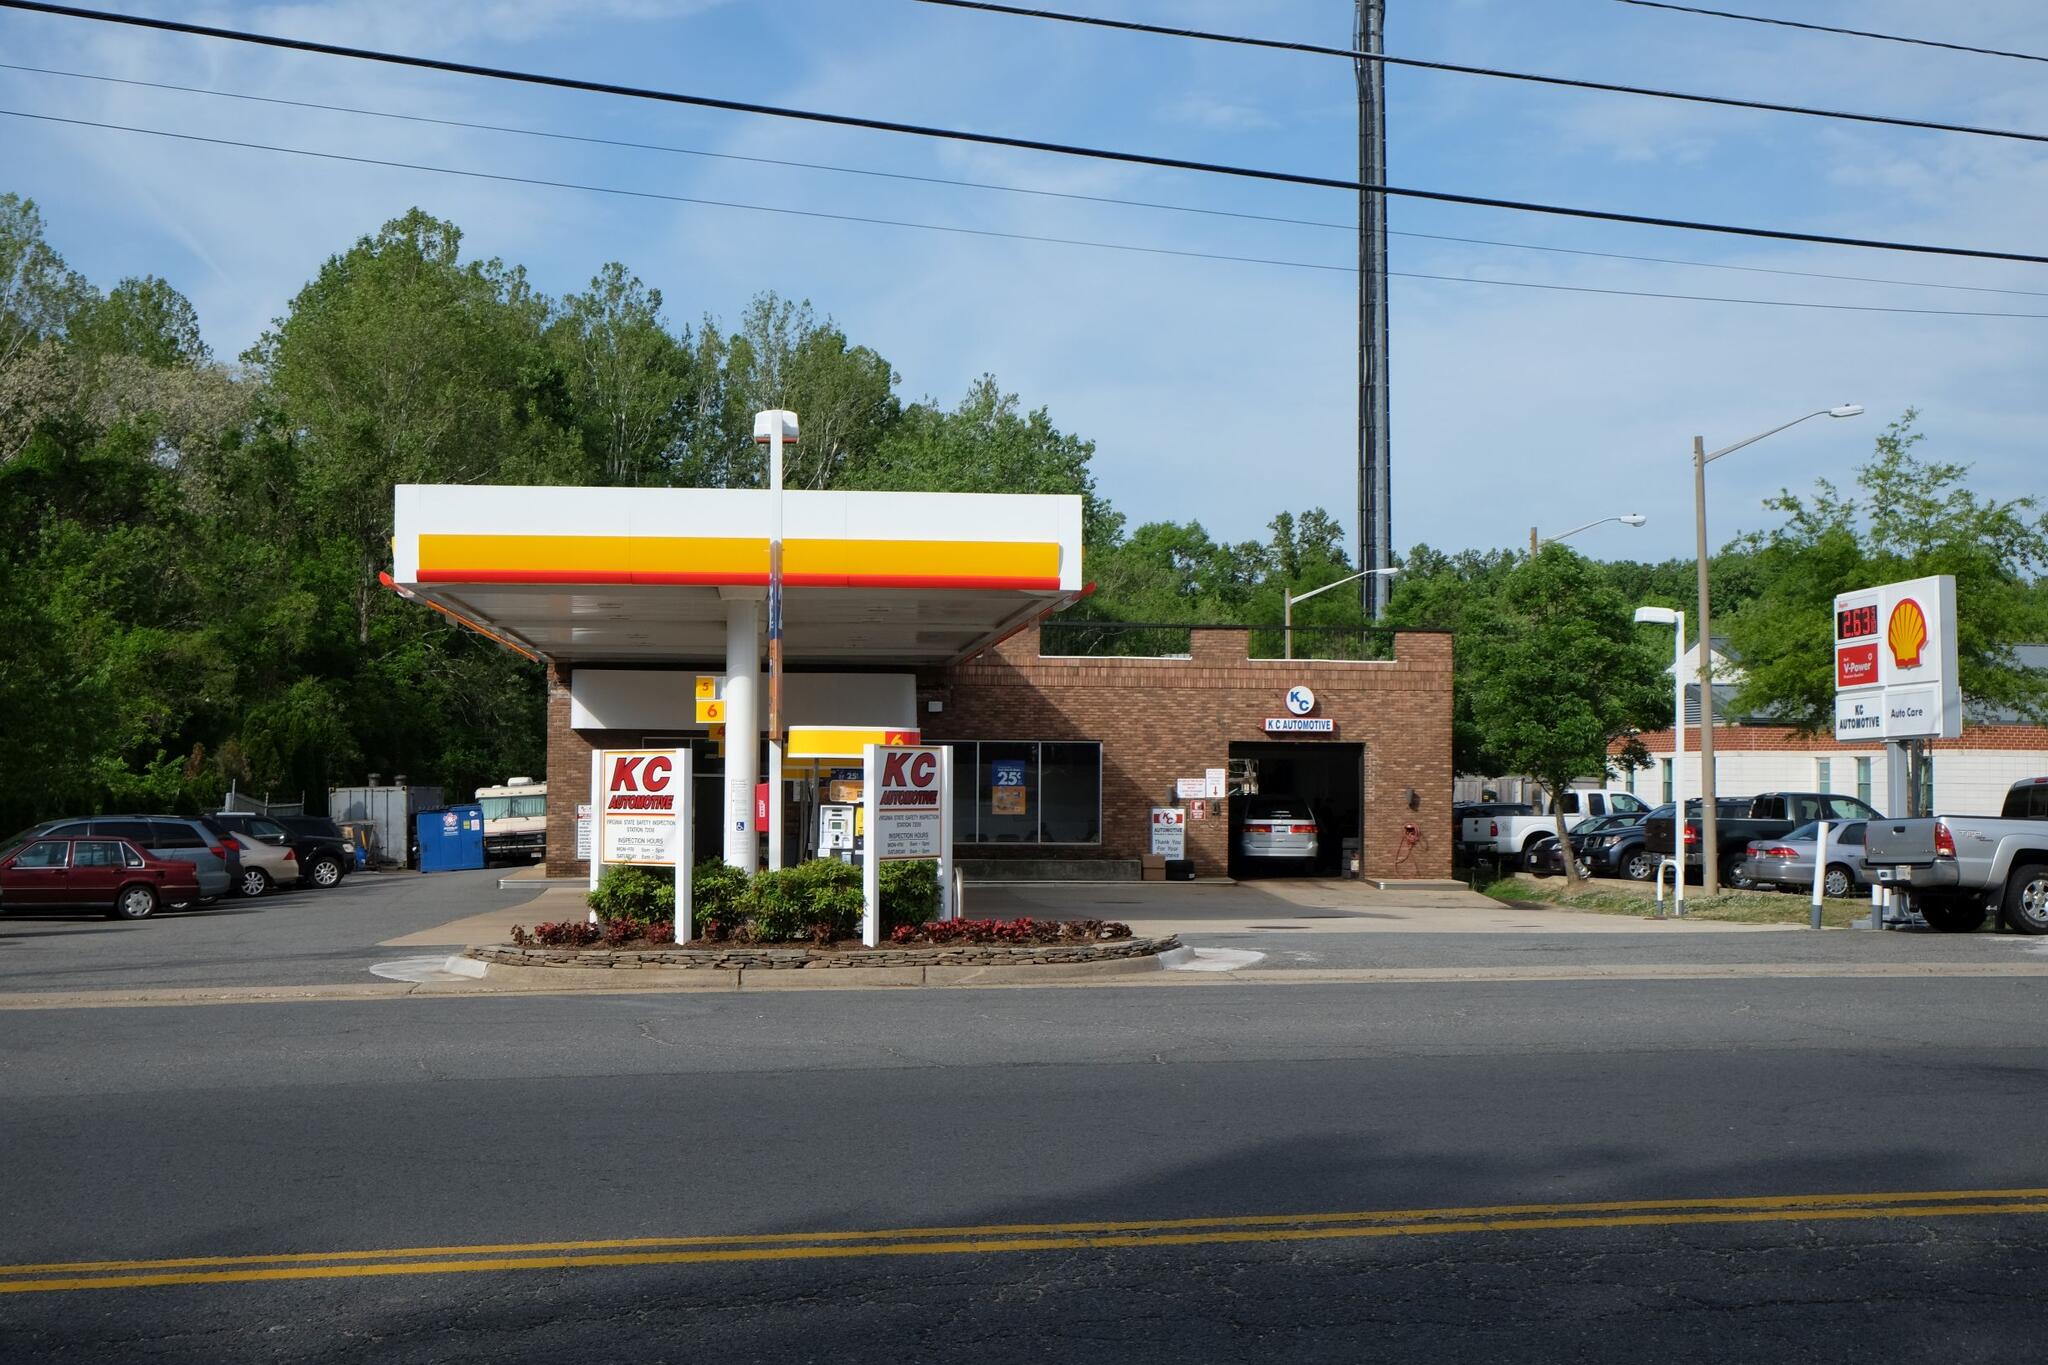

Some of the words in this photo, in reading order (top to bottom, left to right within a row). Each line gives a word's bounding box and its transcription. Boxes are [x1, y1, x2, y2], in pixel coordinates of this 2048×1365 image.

[1843, 607, 1870, 637] 2.63
[1843, 662, 1872, 674] V-Power
[703, 682, 709, 691] 5
[1290, 691, 1309, 711] KC
[707, 704, 717, 718] 6
[1854, 704, 1864, 716] KC
[1891, 709, 1905, 718] Auto
[1906, 707, 1923, 717] Care
[1268, 720, 1273, 729] K
[1275, 720, 1280, 729] C
[1283, 720, 1330, 729] AUTOMOTIVE
[1839, 716, 1880, 729] AUTOMOTIVE
[610, 756, 672, 792] KC
[882, 752, 937, 787] KC
[608, 795, 674, 810] AUTOMOTIVE
[880, 790, 938, 805] AUTOMOTIVE
